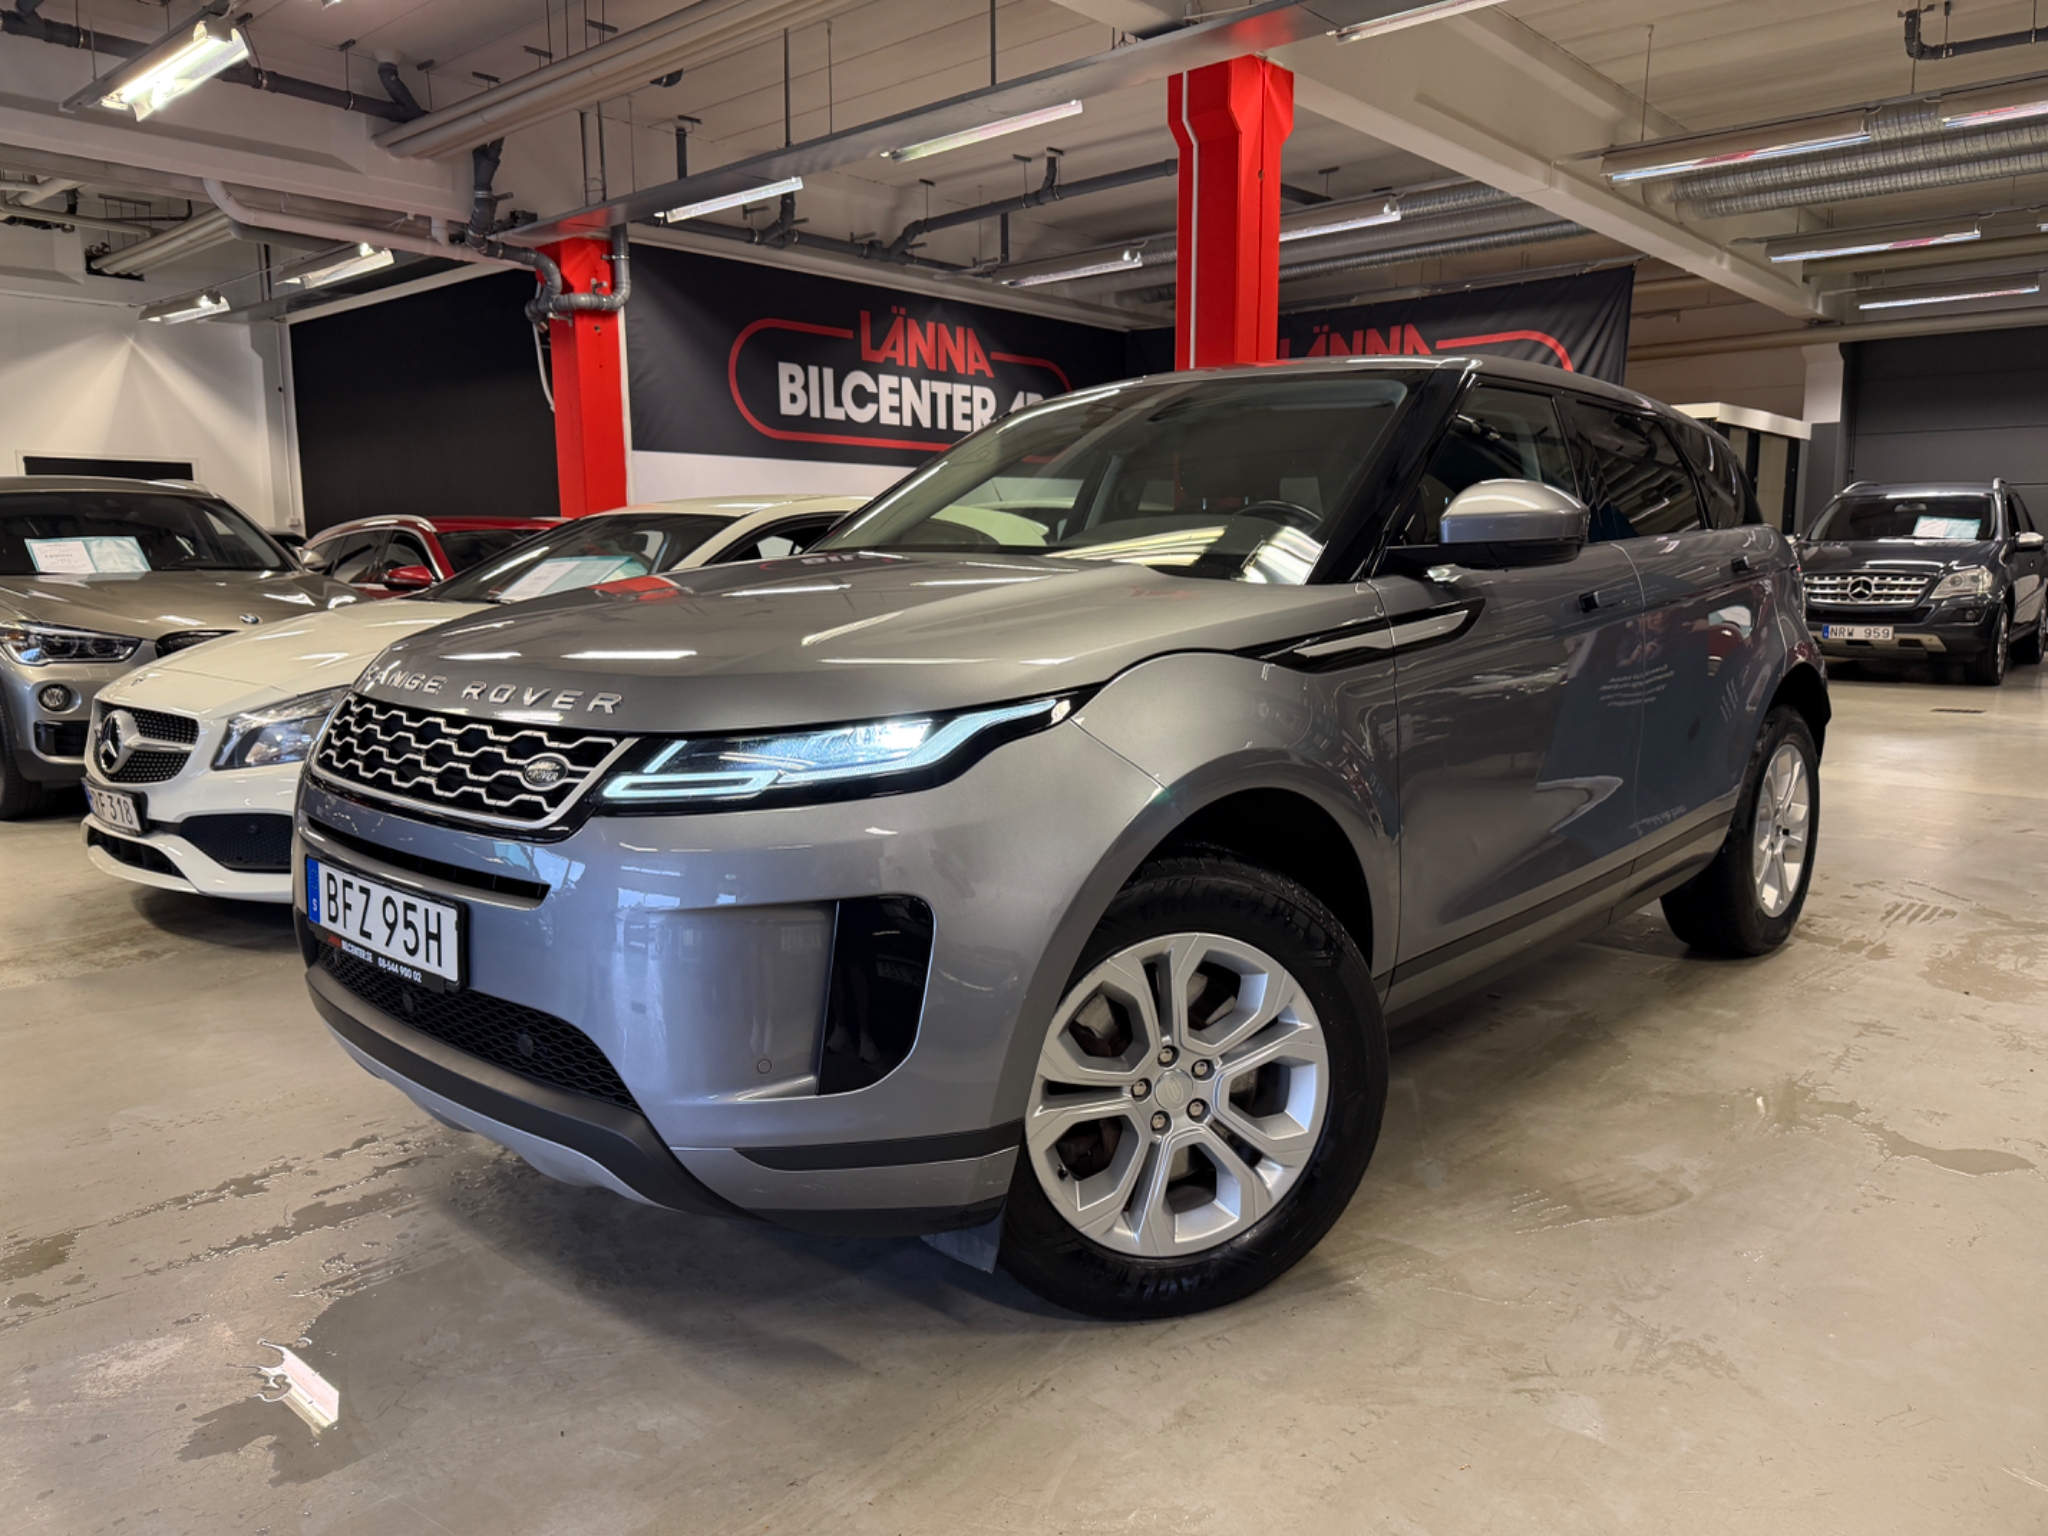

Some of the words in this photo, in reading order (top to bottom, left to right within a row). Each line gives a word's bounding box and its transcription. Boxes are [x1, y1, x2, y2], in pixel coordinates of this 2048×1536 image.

[860, 306, 995, 378] LÄNNA
[778, 362, 996, 433] BILCENTER
[1829, 626, 1855, 638] NRW
[1864, 627, 1890, 639] 959
[365, 663, 448, 695] RANGE
[461, 680, 624, 714] ROVER
[107, 795, 133, 825] 318
[327, 872, 373, 941] BFZ
[382, 895, 443, 968] 95H
